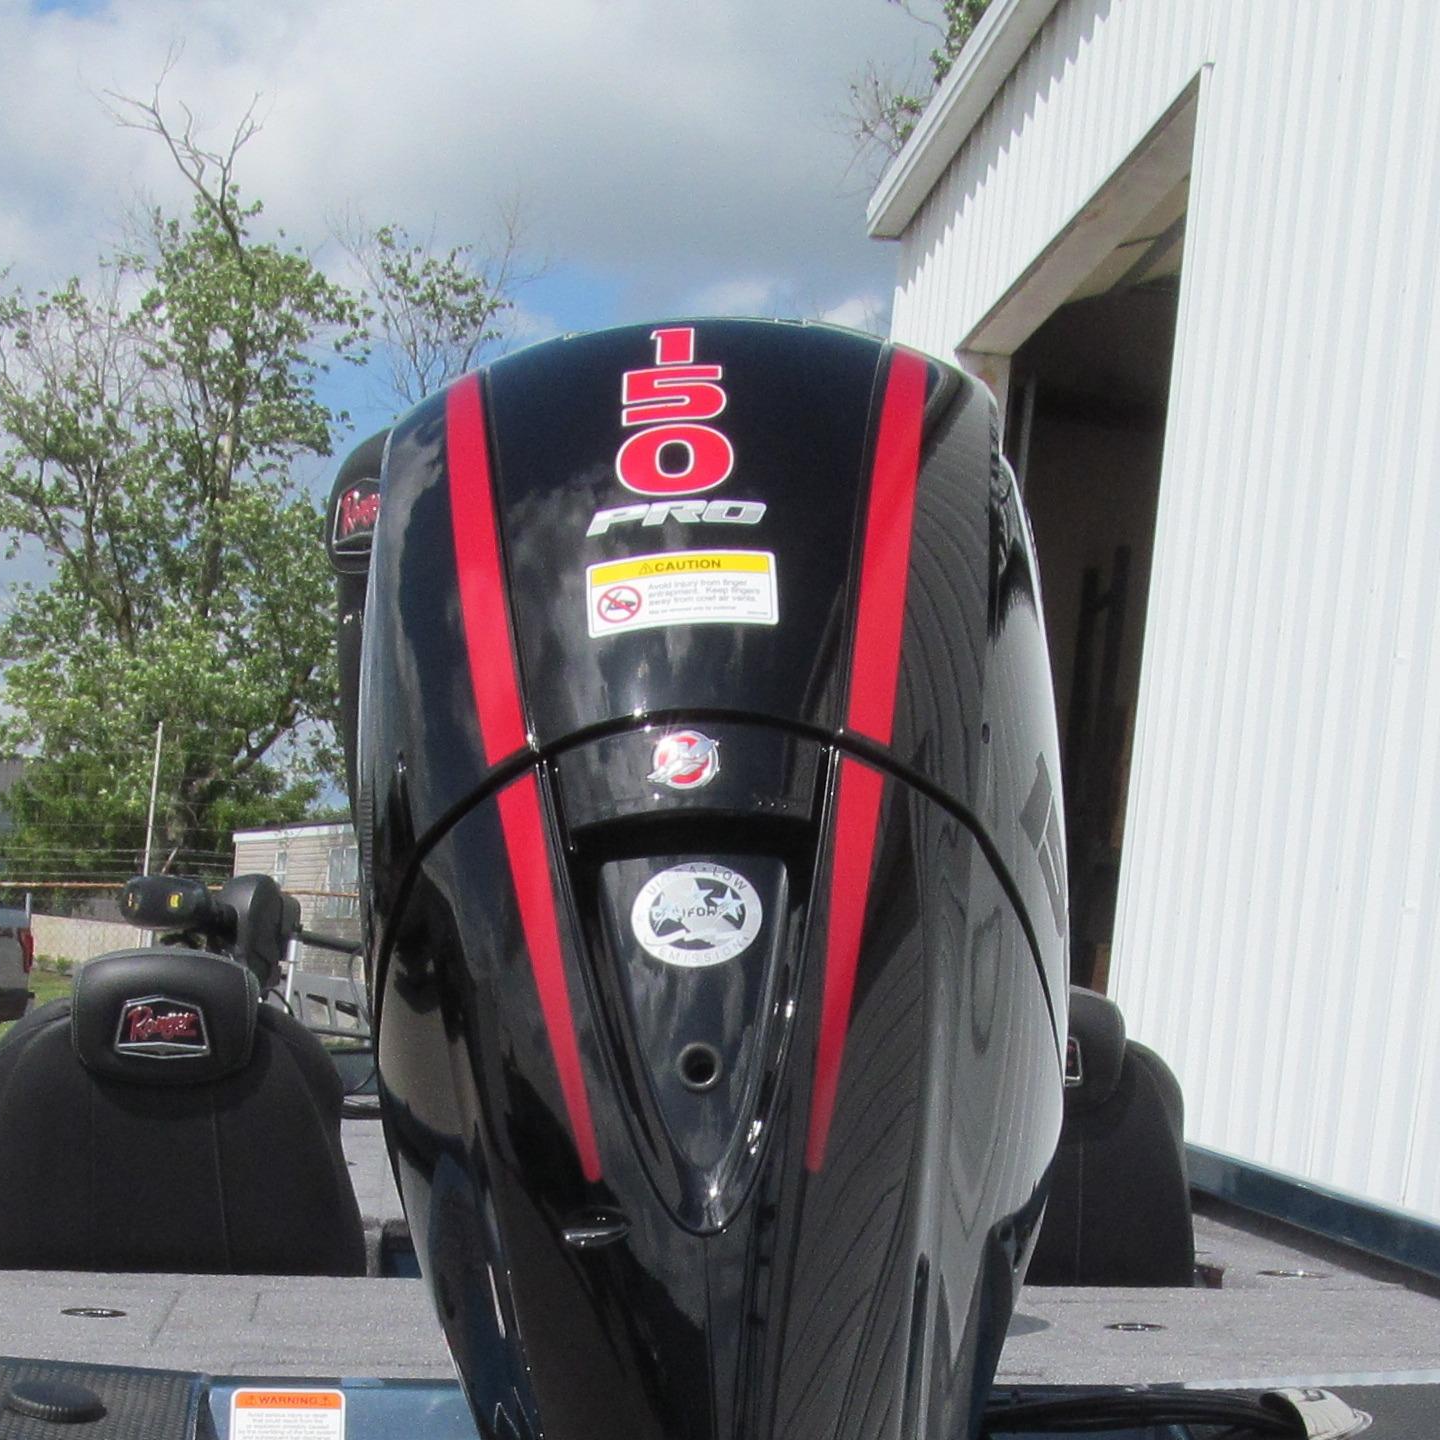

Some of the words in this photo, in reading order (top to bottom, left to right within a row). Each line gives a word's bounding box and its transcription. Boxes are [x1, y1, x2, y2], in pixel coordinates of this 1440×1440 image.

[615, 327, 735, 497] 150
[585, 499, 767, 538] PRO
[654, 559, 722, 572] CAUTION
[712, 866, 748, 890] LOW
[259, 1396, 318, 1405] WARNING
